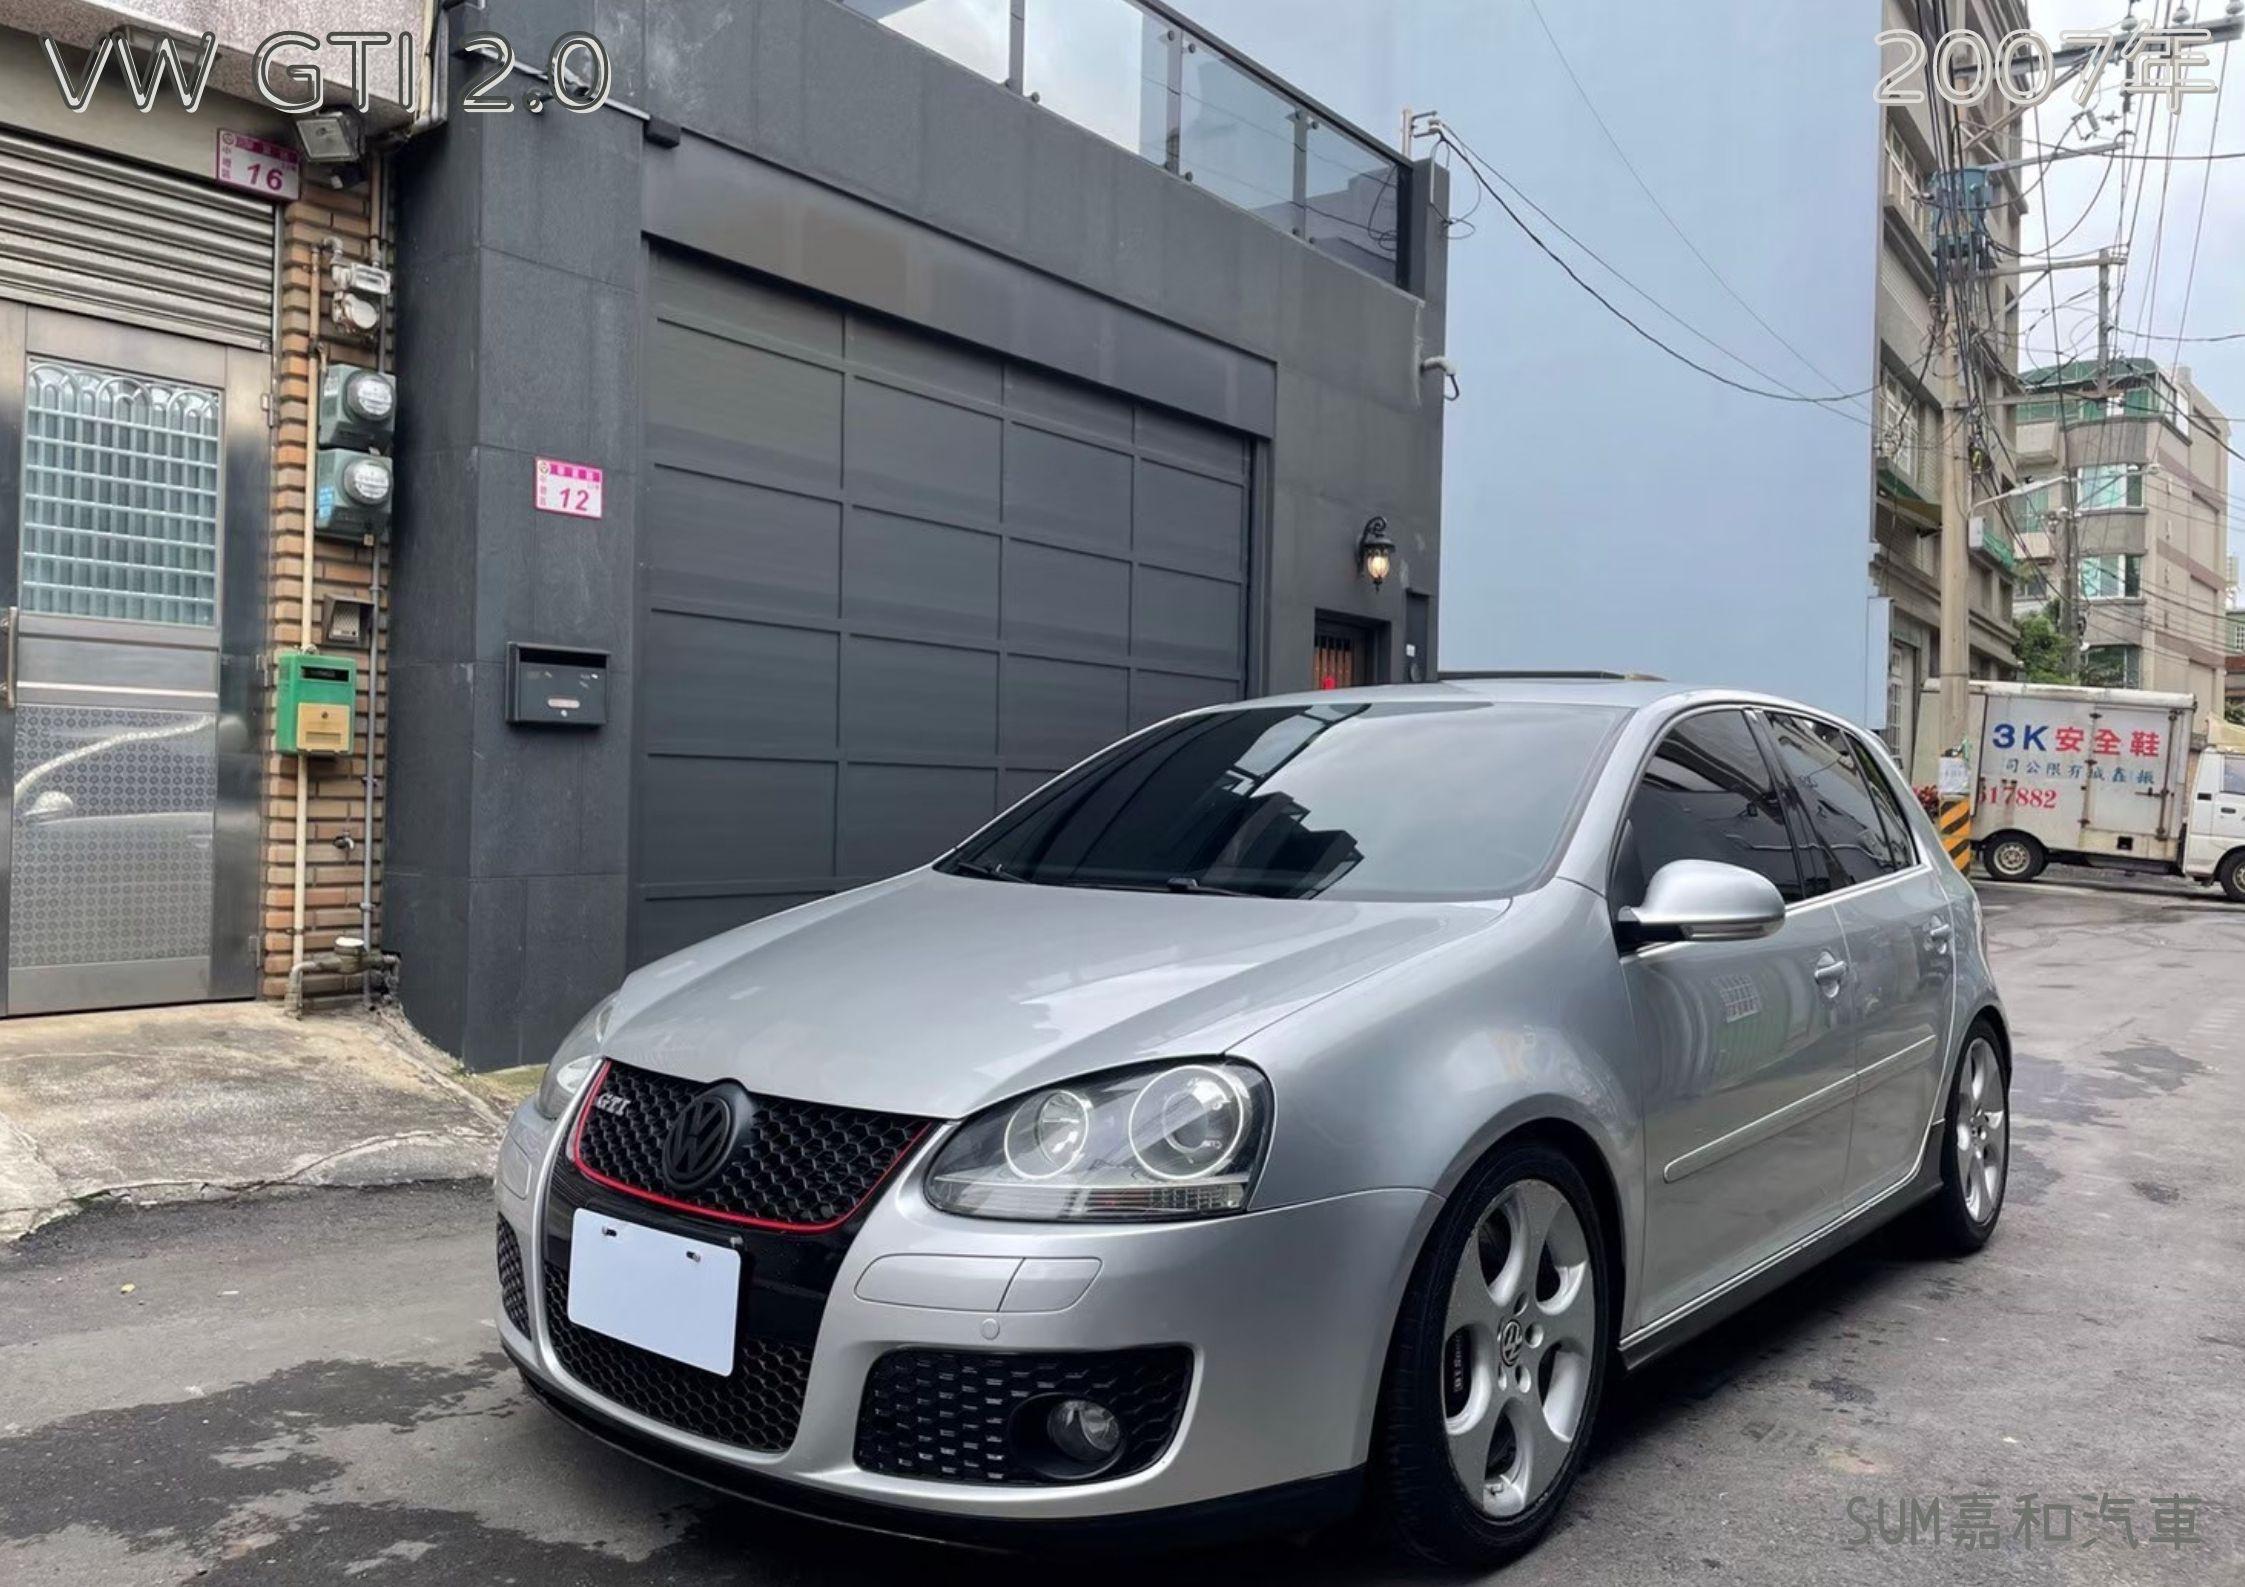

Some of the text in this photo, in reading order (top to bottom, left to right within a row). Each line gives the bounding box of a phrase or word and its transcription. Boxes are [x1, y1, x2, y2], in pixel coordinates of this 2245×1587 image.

[247, 163, 284, 191] 16
[560, 487, 590, 512] 12
[596, 1092, 631, 1116] GTI
